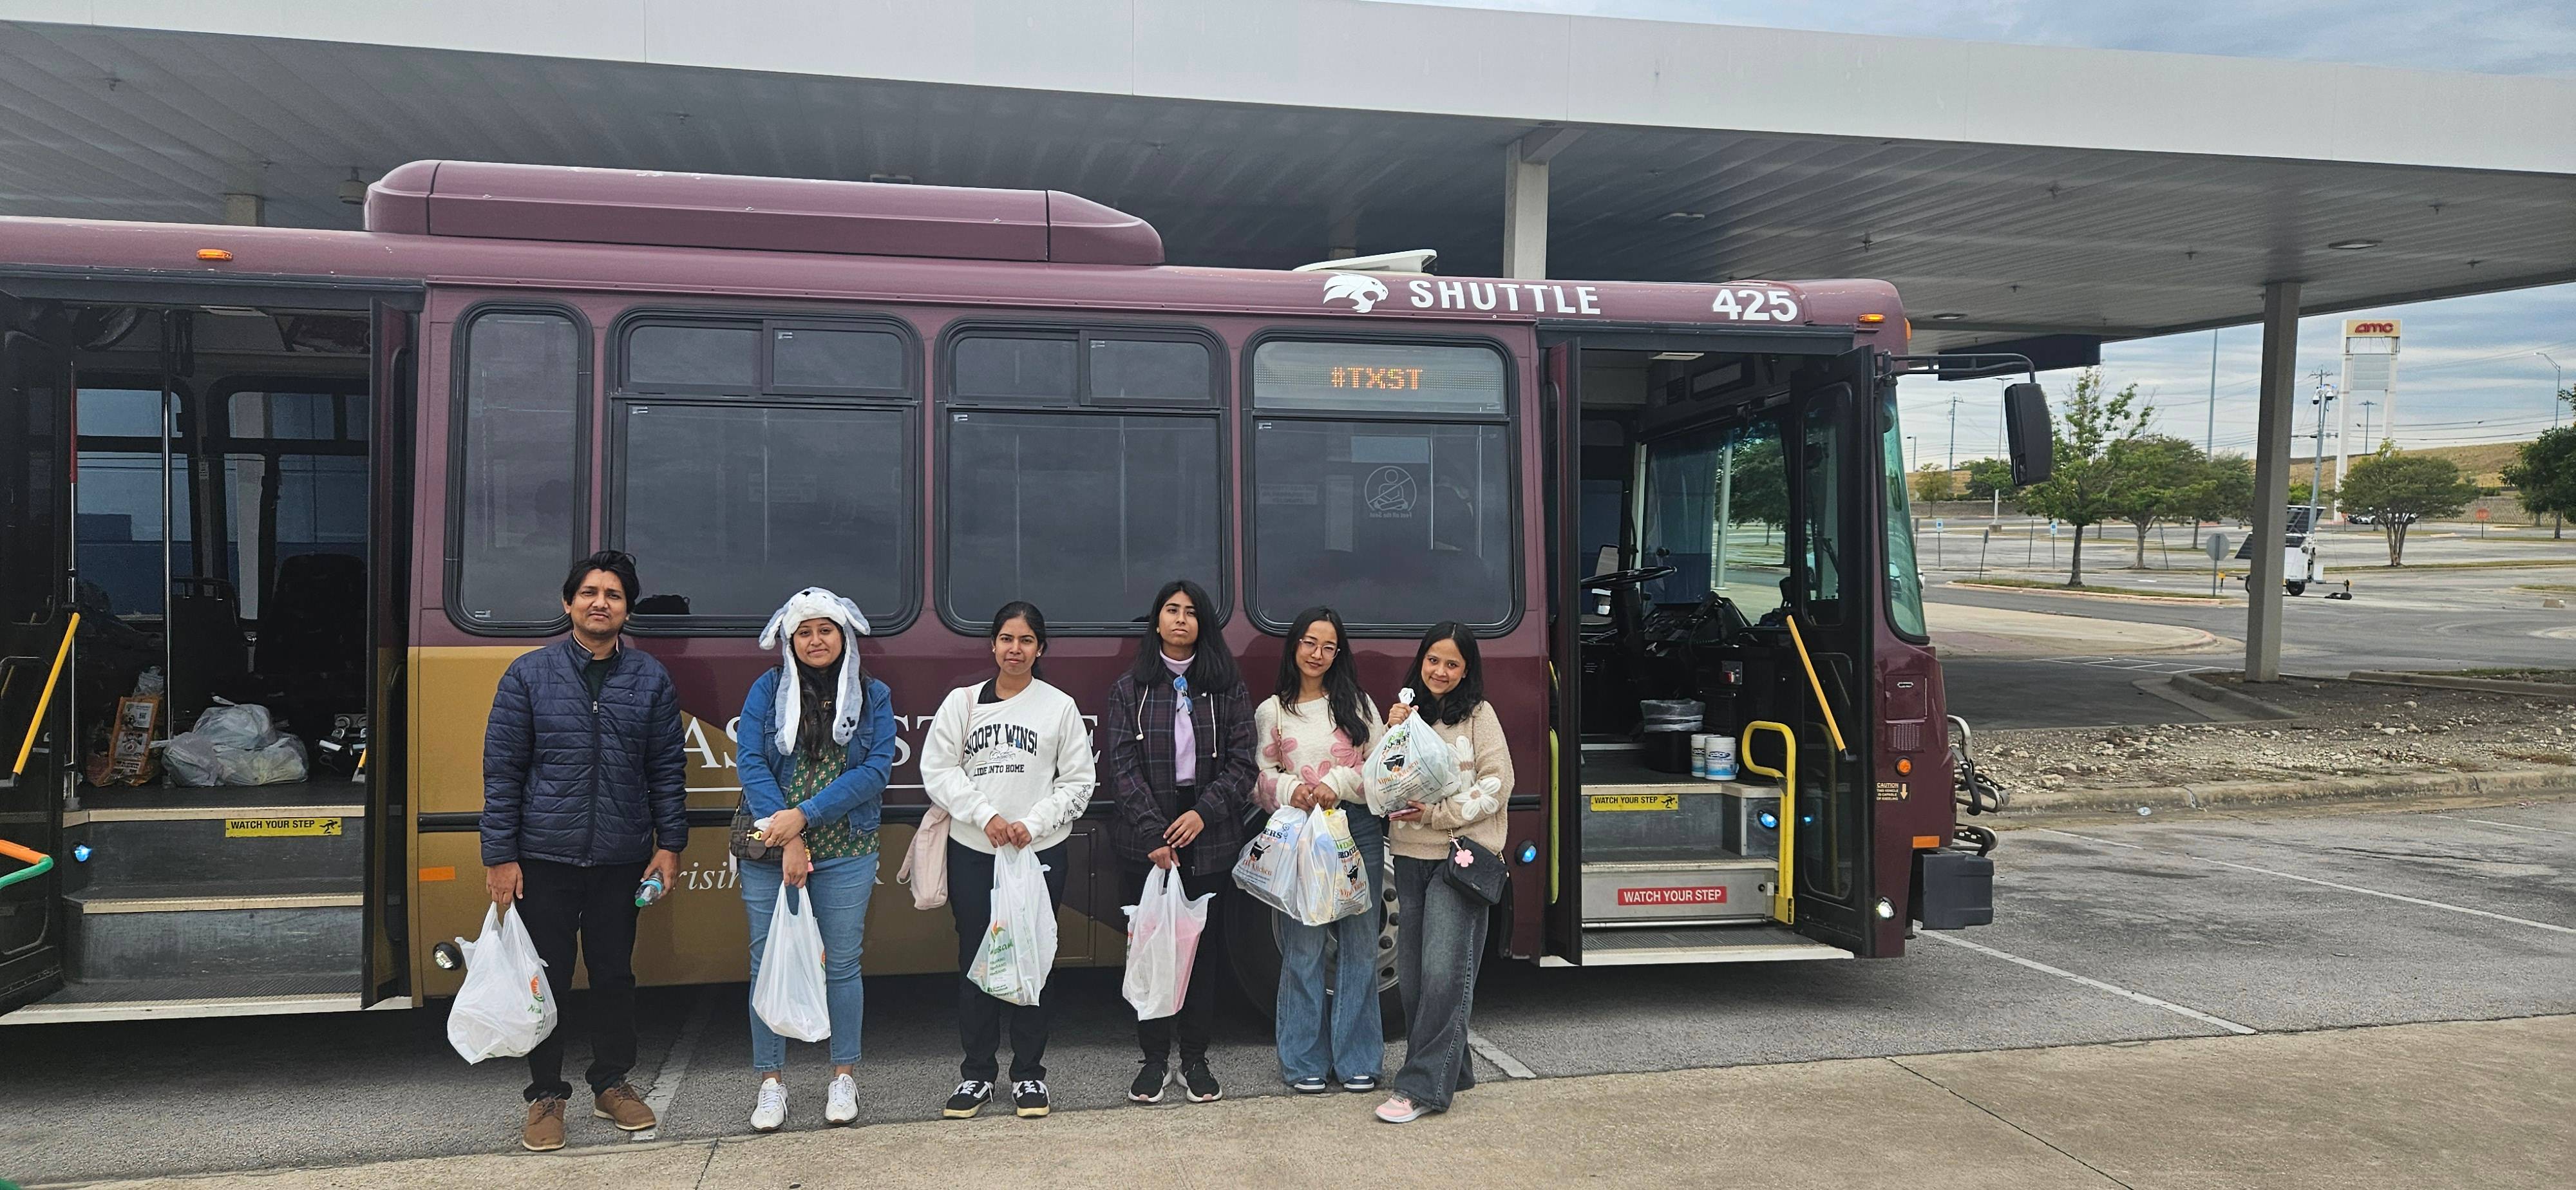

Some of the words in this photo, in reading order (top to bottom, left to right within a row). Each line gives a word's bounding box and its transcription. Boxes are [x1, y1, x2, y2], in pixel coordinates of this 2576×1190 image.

[1409, 280, 1601, 315] SHUTTLE
[1712, 288, 1797, 322] 425
[1331, 366, 1423, 390] #TXST
[964, 723, 1001, 759] NOOPY
[1005, 723, 1037, 757] WINS!
[973, 766, 988, 777] LIDE
[1005, 764, 1025, 773] HOME
[231, 820, 262, 829] WATCH
[265, 820, 289, 829] YOUR
[292, 820, 315, 828] STEP
[1624, 891, 1661, 902] WATCH
[1663, 890, 1692, 902] YOUR
[1695, 889, 1721, 901] STEP
